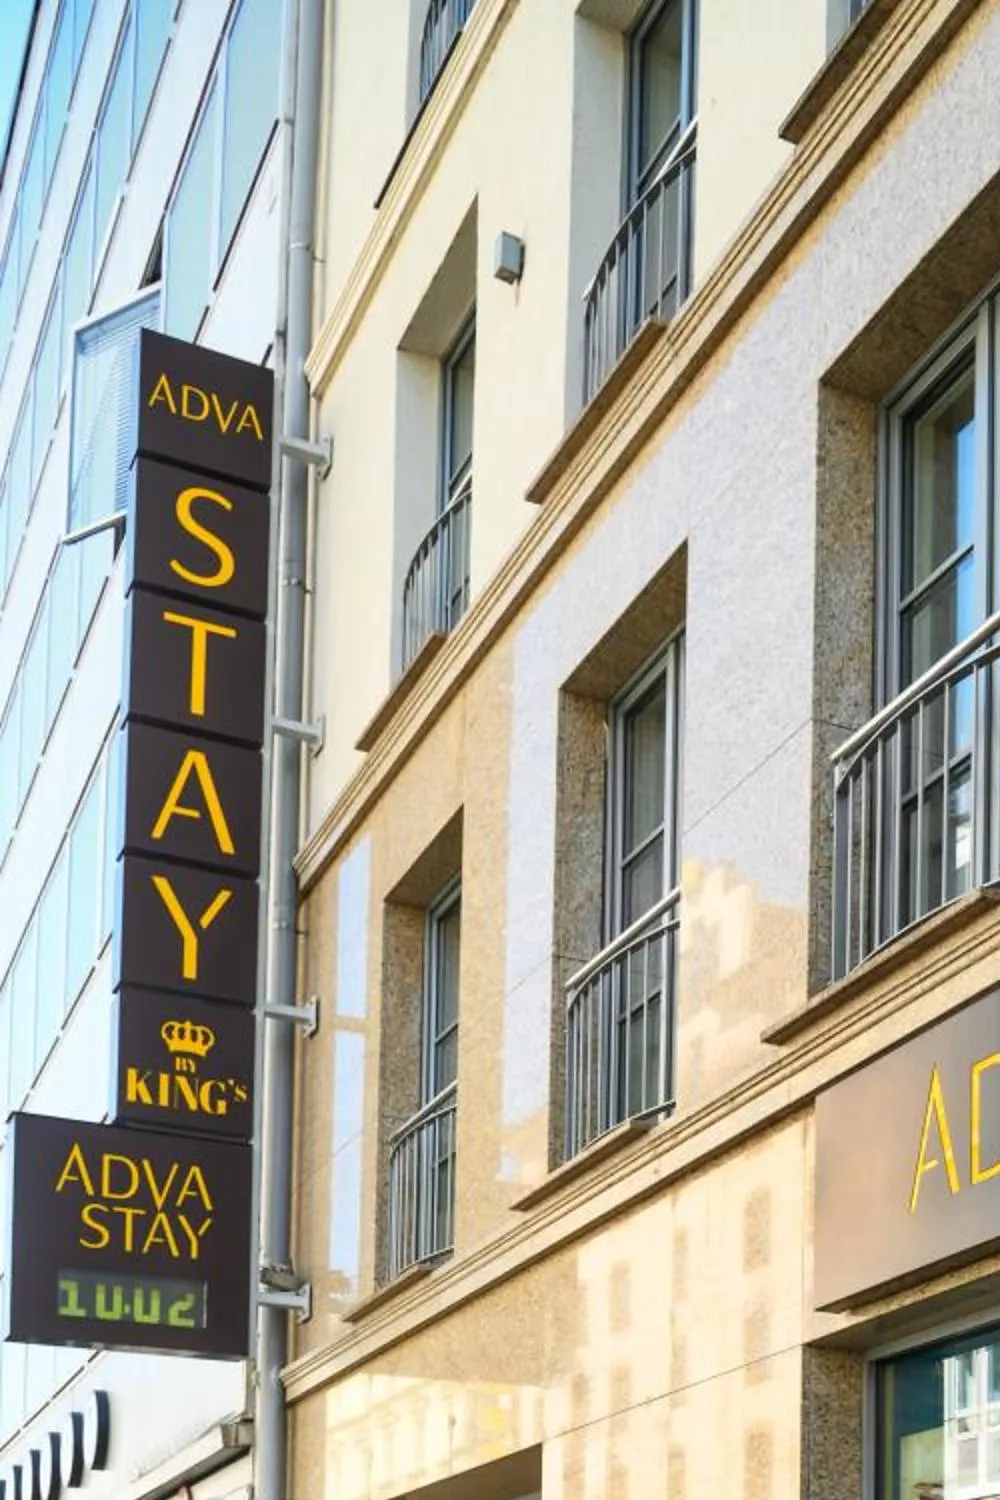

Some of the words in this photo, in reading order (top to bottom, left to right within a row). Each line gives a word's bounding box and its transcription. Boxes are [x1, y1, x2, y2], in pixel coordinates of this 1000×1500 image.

[148, 373, 264, 441] ADVA
[151, 487, 236, 980] STAY
[56, 1142, 213, 1212] ADVA
[79, 1203, 213, 1260] STAY
